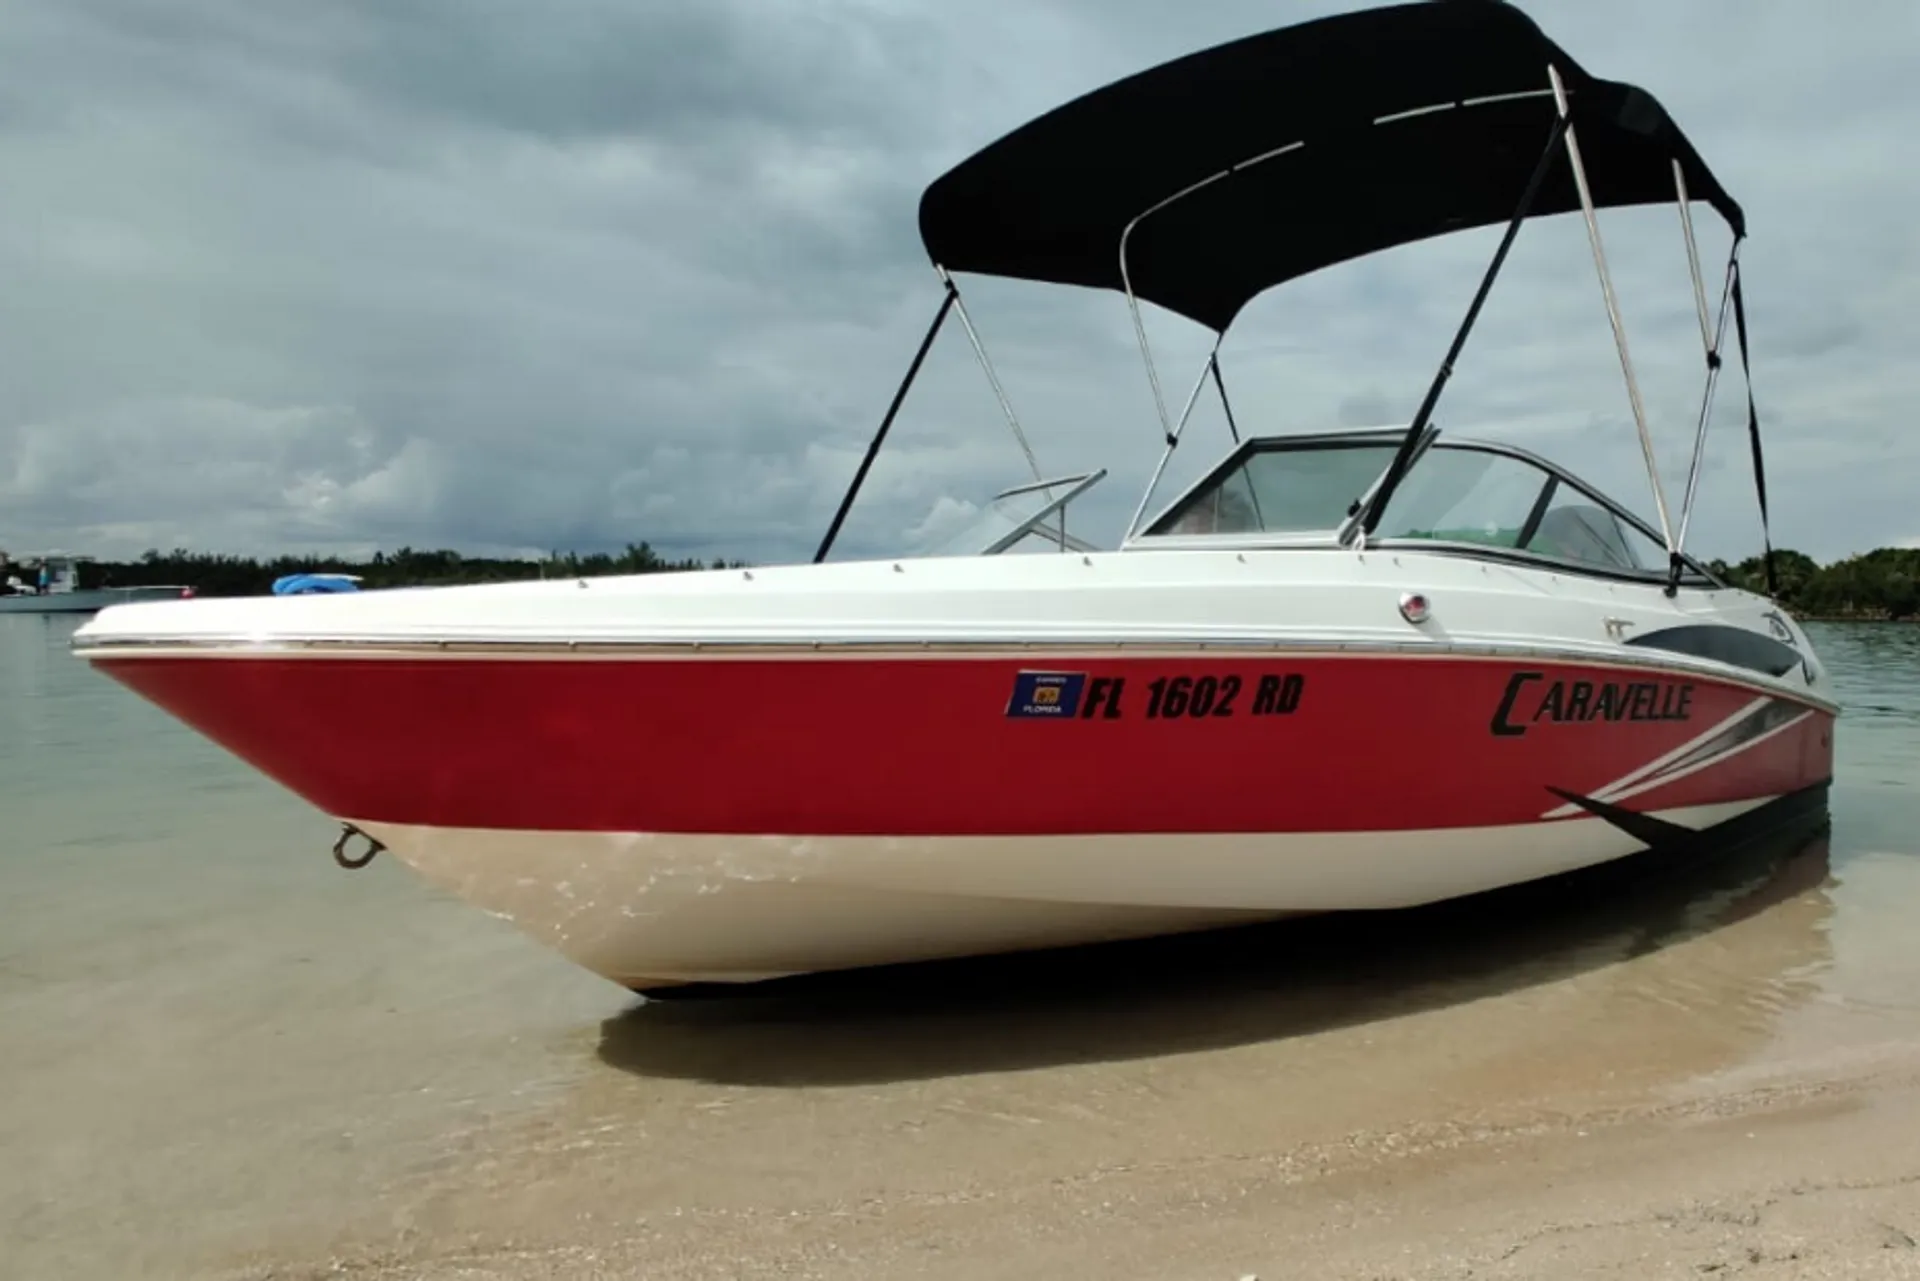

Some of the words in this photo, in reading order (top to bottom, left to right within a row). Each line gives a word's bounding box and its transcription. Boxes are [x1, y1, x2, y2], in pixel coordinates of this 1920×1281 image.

[1023, 705, 1062, 713] FLORIDA
[1082, 677, 1126, 718] FL
[1147, 675, 1242, 718] 1602
[1252, 674, 1304, 715] RD
[1490, 672, 1694, 736] CARAVELLE
